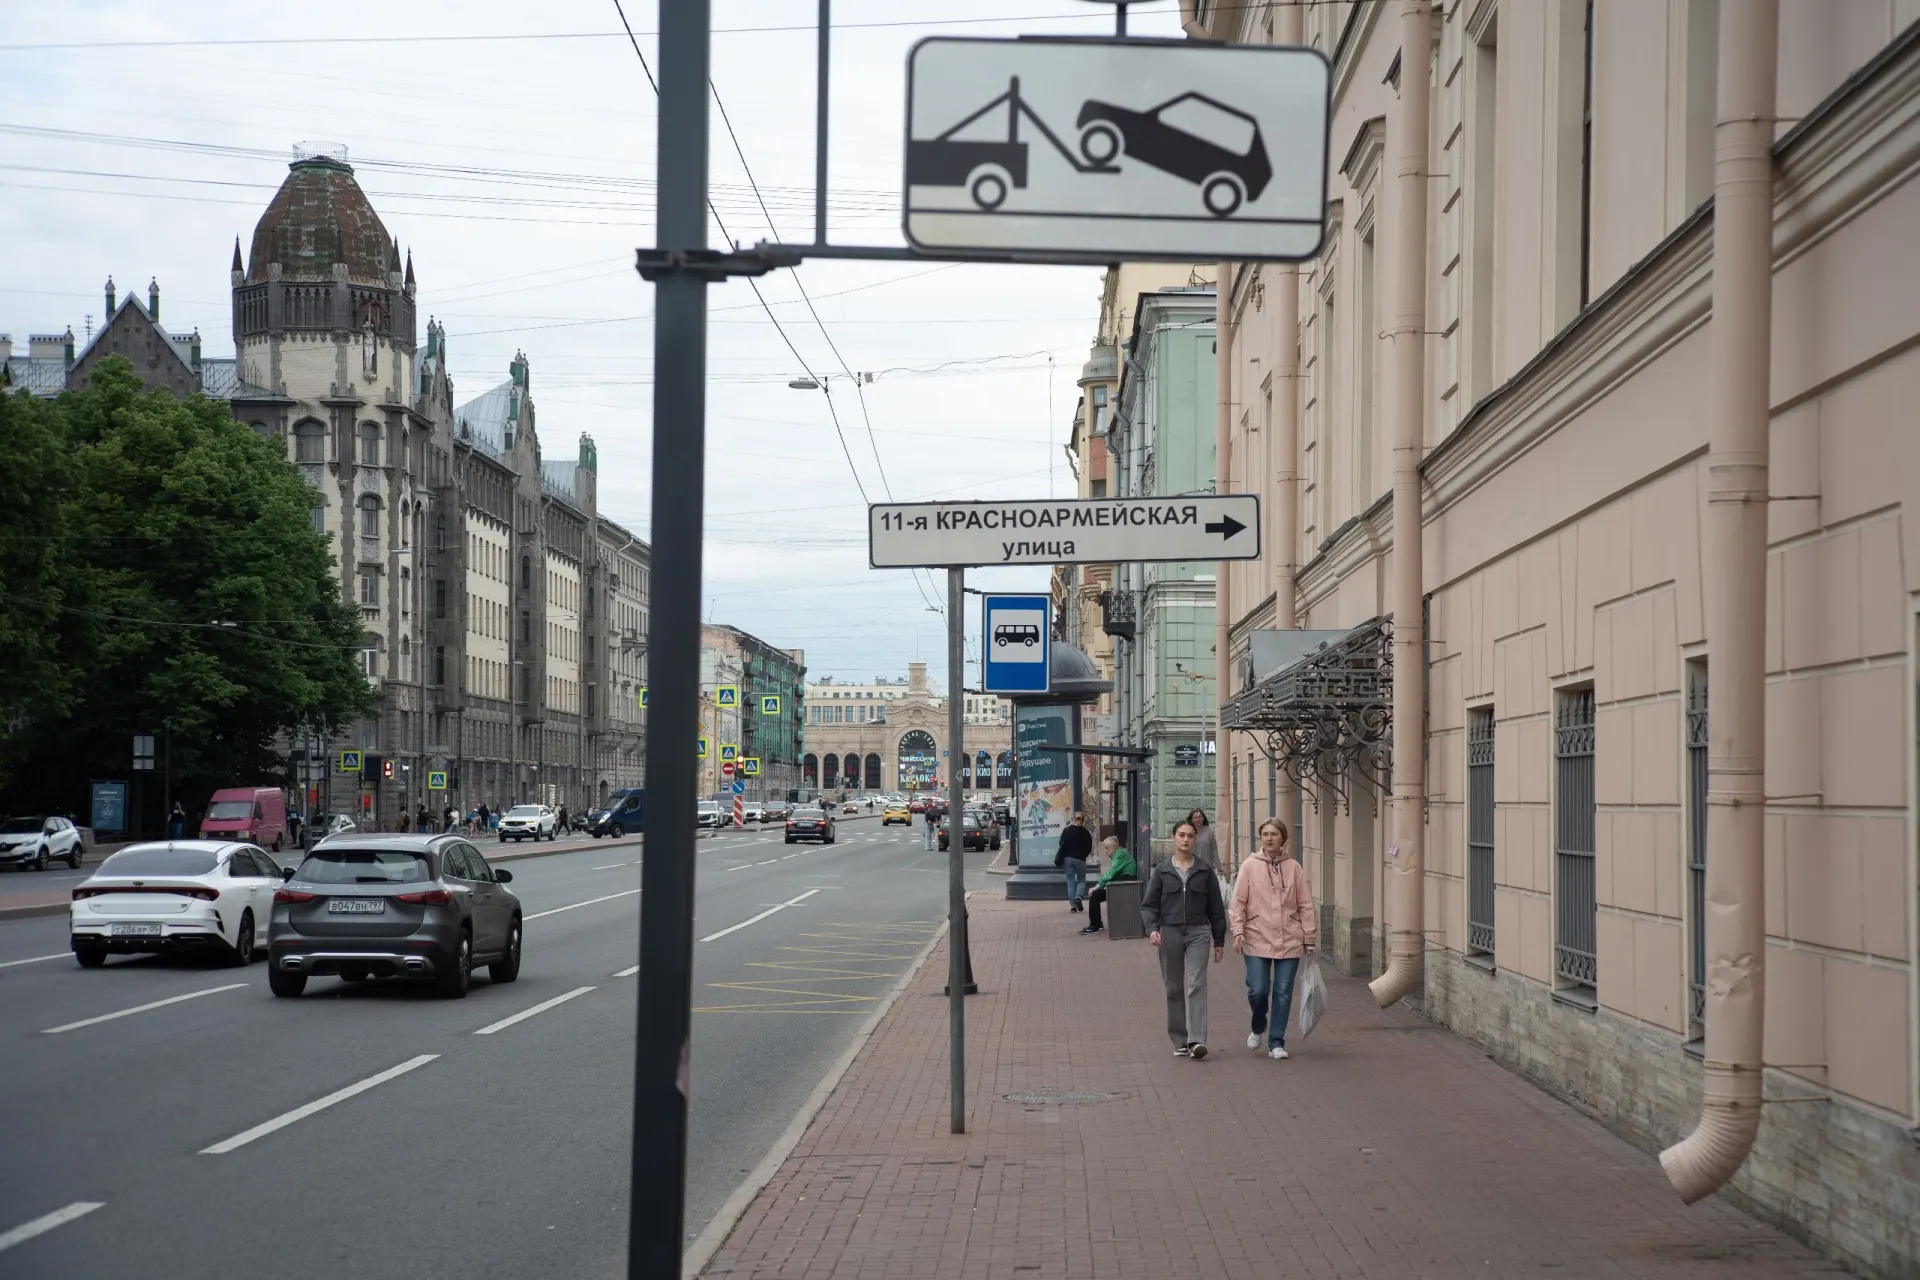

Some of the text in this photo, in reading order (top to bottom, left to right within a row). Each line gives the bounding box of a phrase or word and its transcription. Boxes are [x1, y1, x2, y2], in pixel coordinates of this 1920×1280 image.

[880, 502, 1198, 531] 11-я КРАСНОАРМЕЙСКАЯ
[1002, 540, 1076, 561] улица
[997, 767, 1013, 777] CITY
